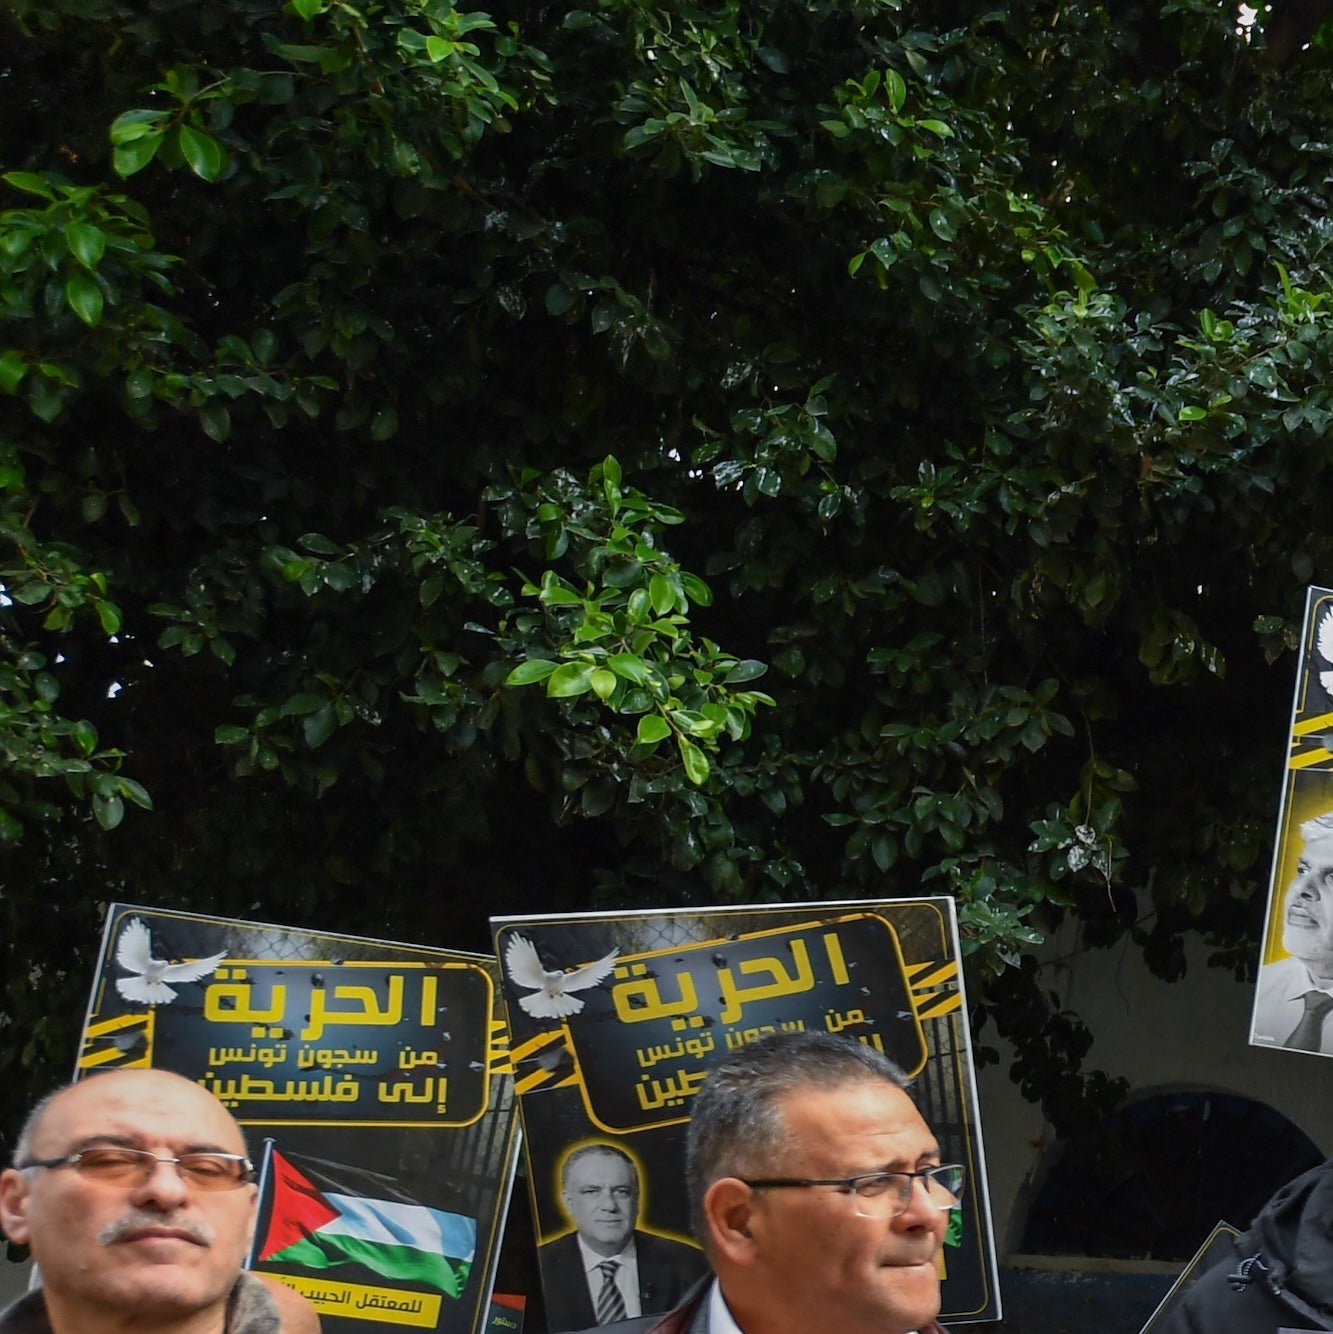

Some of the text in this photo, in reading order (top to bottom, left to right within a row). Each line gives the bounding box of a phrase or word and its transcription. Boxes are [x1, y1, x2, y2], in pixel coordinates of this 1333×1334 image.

[611, 932, 849, 1031] الحرية
[203, 968, 438, 1042] الحرية
[824, 1007, 866, 1034] من
[208, 1044, 438, 1071] من سجون تونس
[636, 1031, 715, 1069] تونس
[378, 1075, 447, 1114] إلى
[355, 1292, 423, 1314] للمعتقل
